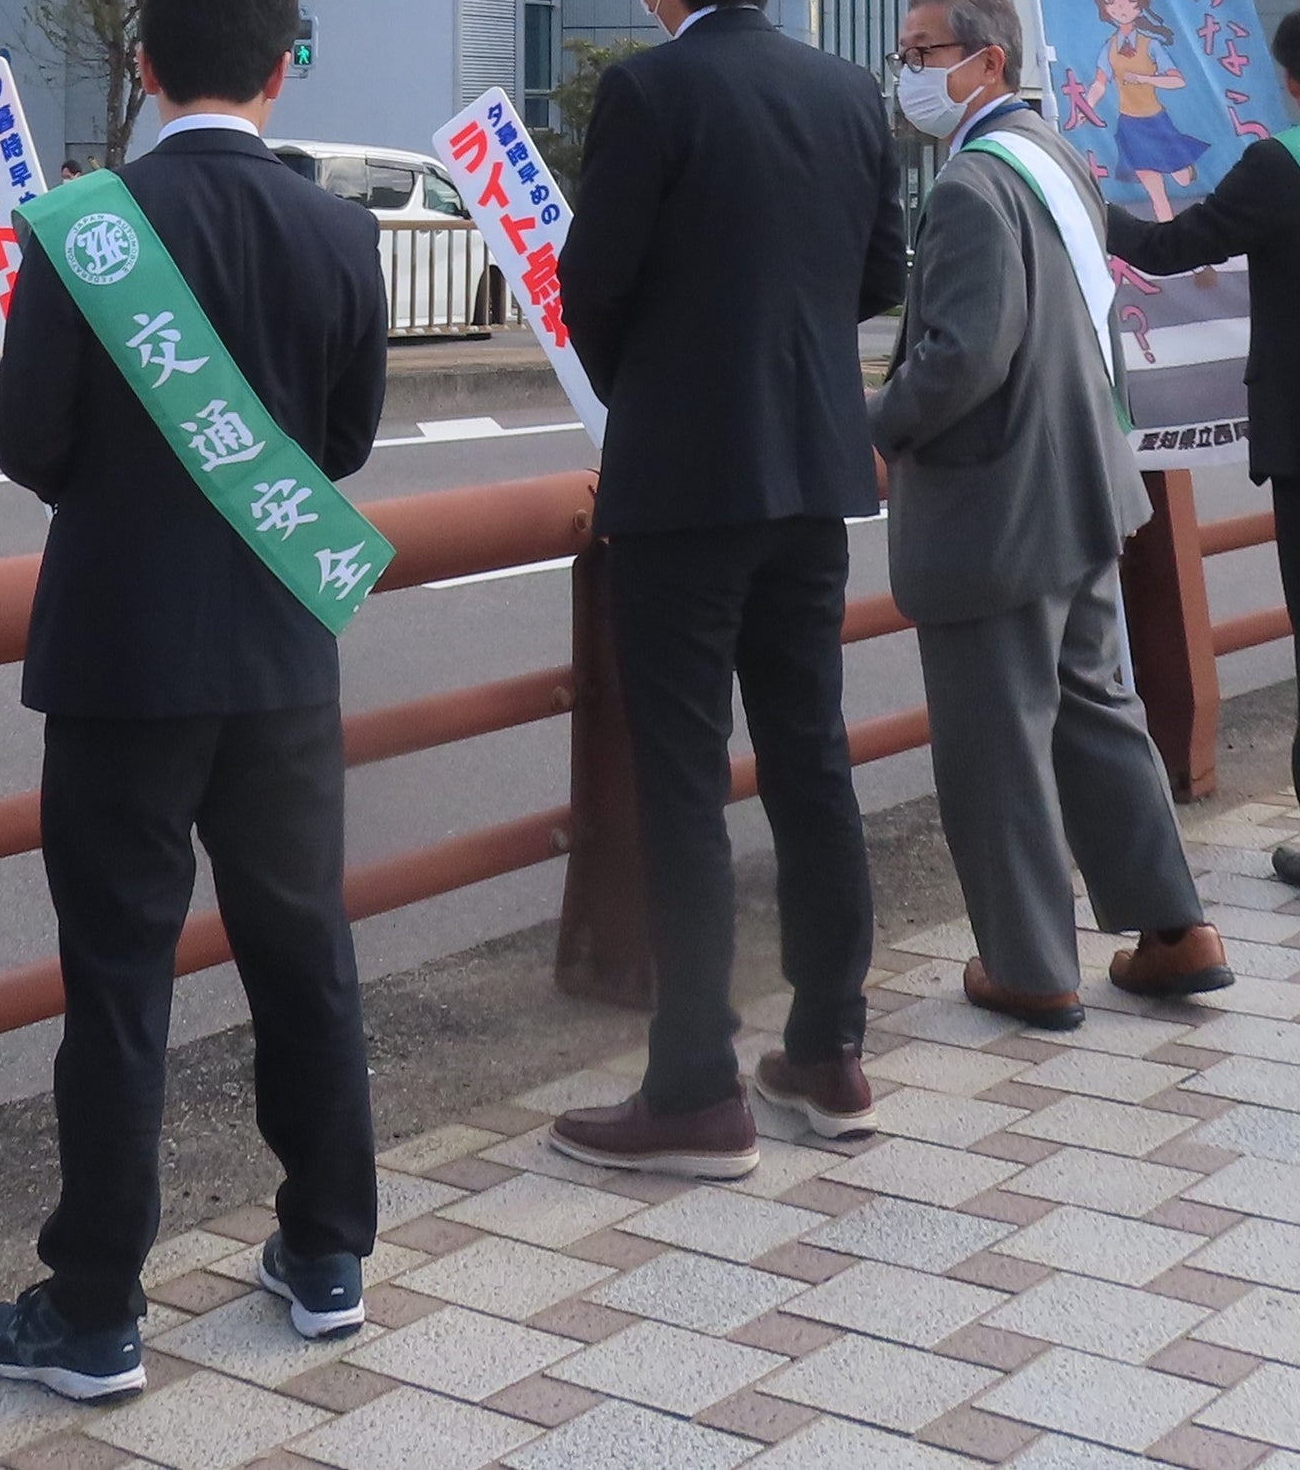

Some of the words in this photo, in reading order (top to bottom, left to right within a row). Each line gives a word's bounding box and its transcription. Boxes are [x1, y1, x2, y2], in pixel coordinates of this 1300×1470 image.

[487, 102, 561, 225] 夕暮時早めの
[126, 311, 372, 600] 交通安全
